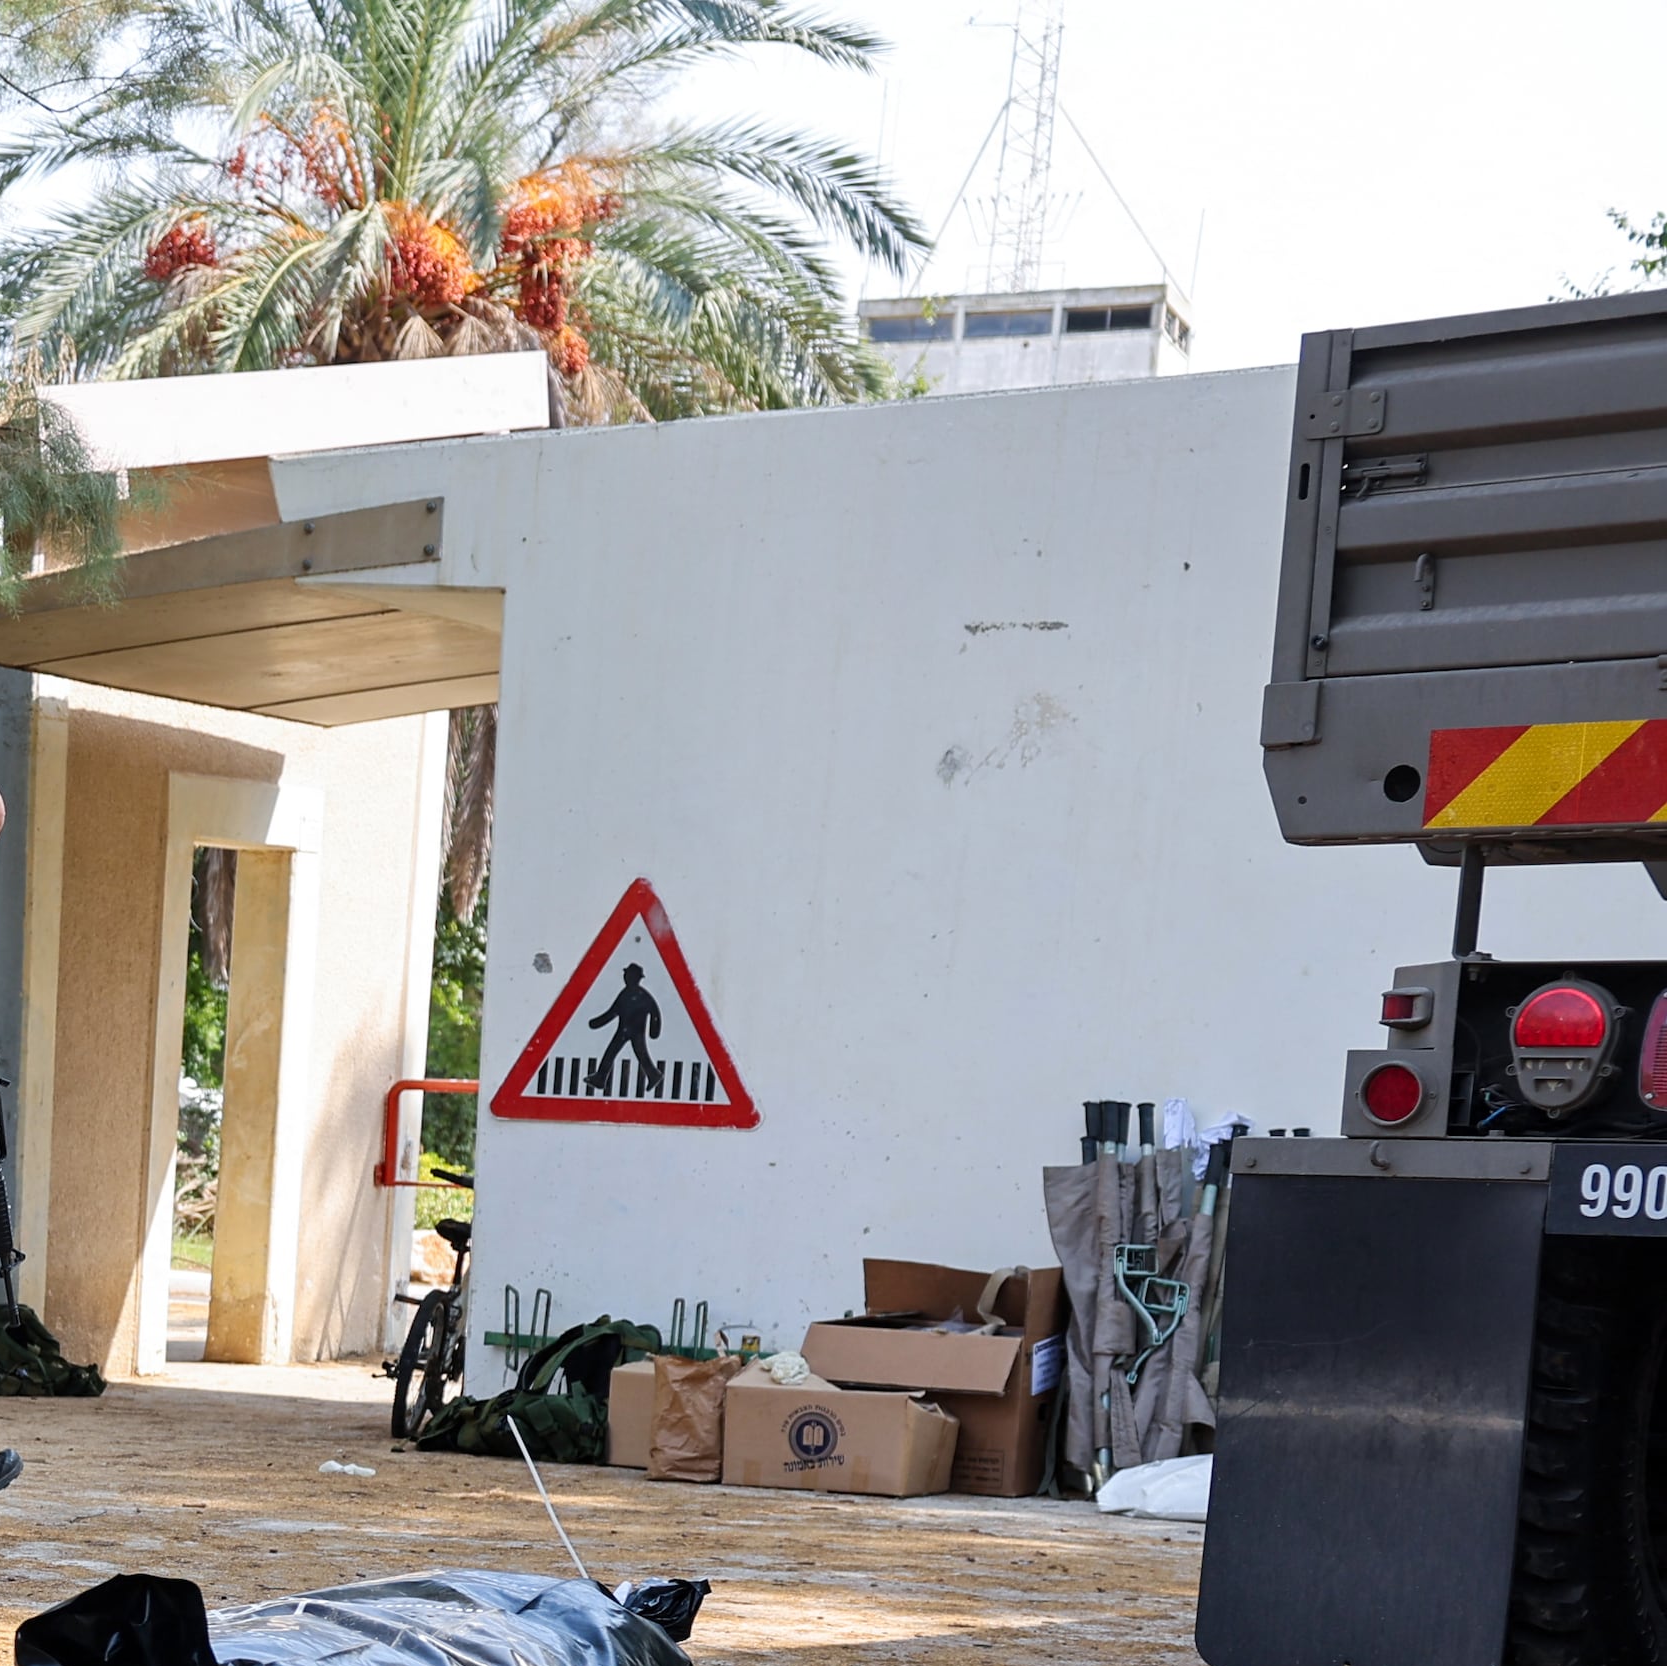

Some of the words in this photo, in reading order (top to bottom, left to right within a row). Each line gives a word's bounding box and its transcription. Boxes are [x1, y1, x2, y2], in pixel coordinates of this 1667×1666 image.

[1579, 1163, 1667, 1220] 990
[783, 1459, 816, 1473] באמונה
[818, 1455, 845, 1468] שירות
